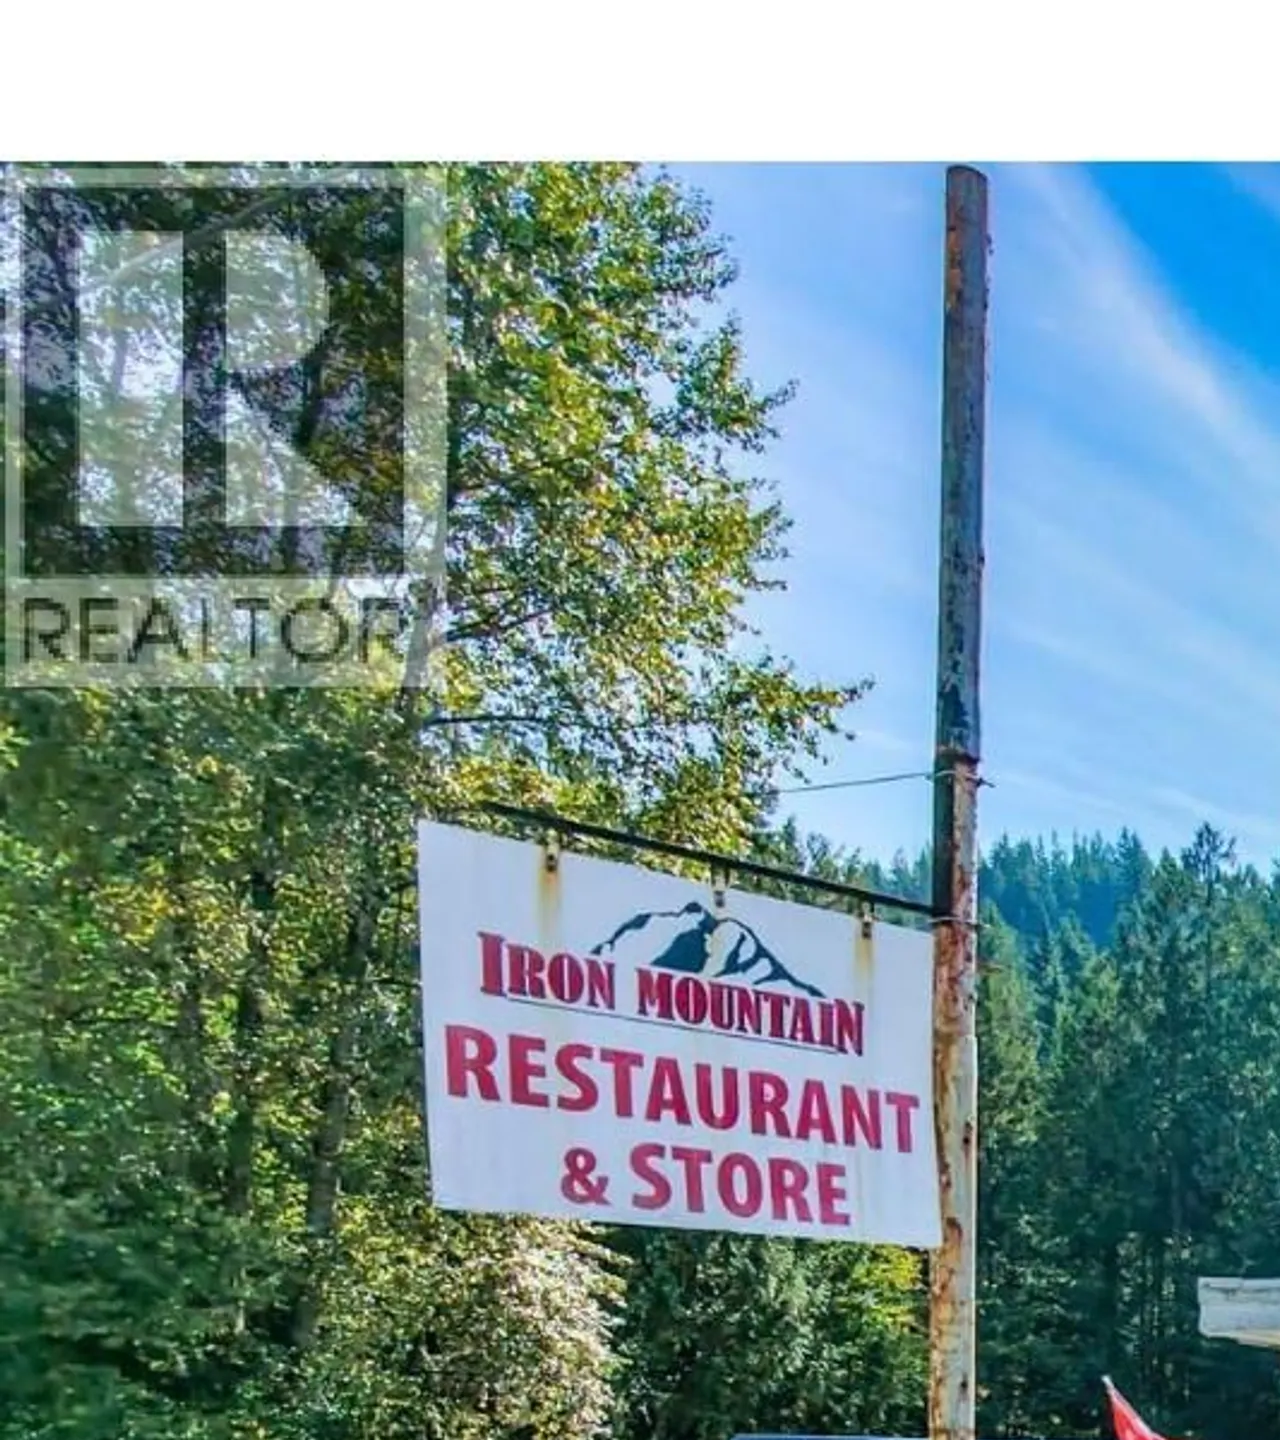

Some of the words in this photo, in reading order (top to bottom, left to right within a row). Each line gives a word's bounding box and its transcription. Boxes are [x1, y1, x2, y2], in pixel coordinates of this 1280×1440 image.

[477, 931, 616, 1010] IRON
[637, 967, 865, 1057] MOUNTAIN
[444, 1024, 921, 1154] RESTAURANT
[560, 1147, 610, 1207] &
[629, 1142, 852, 1227] STORE
